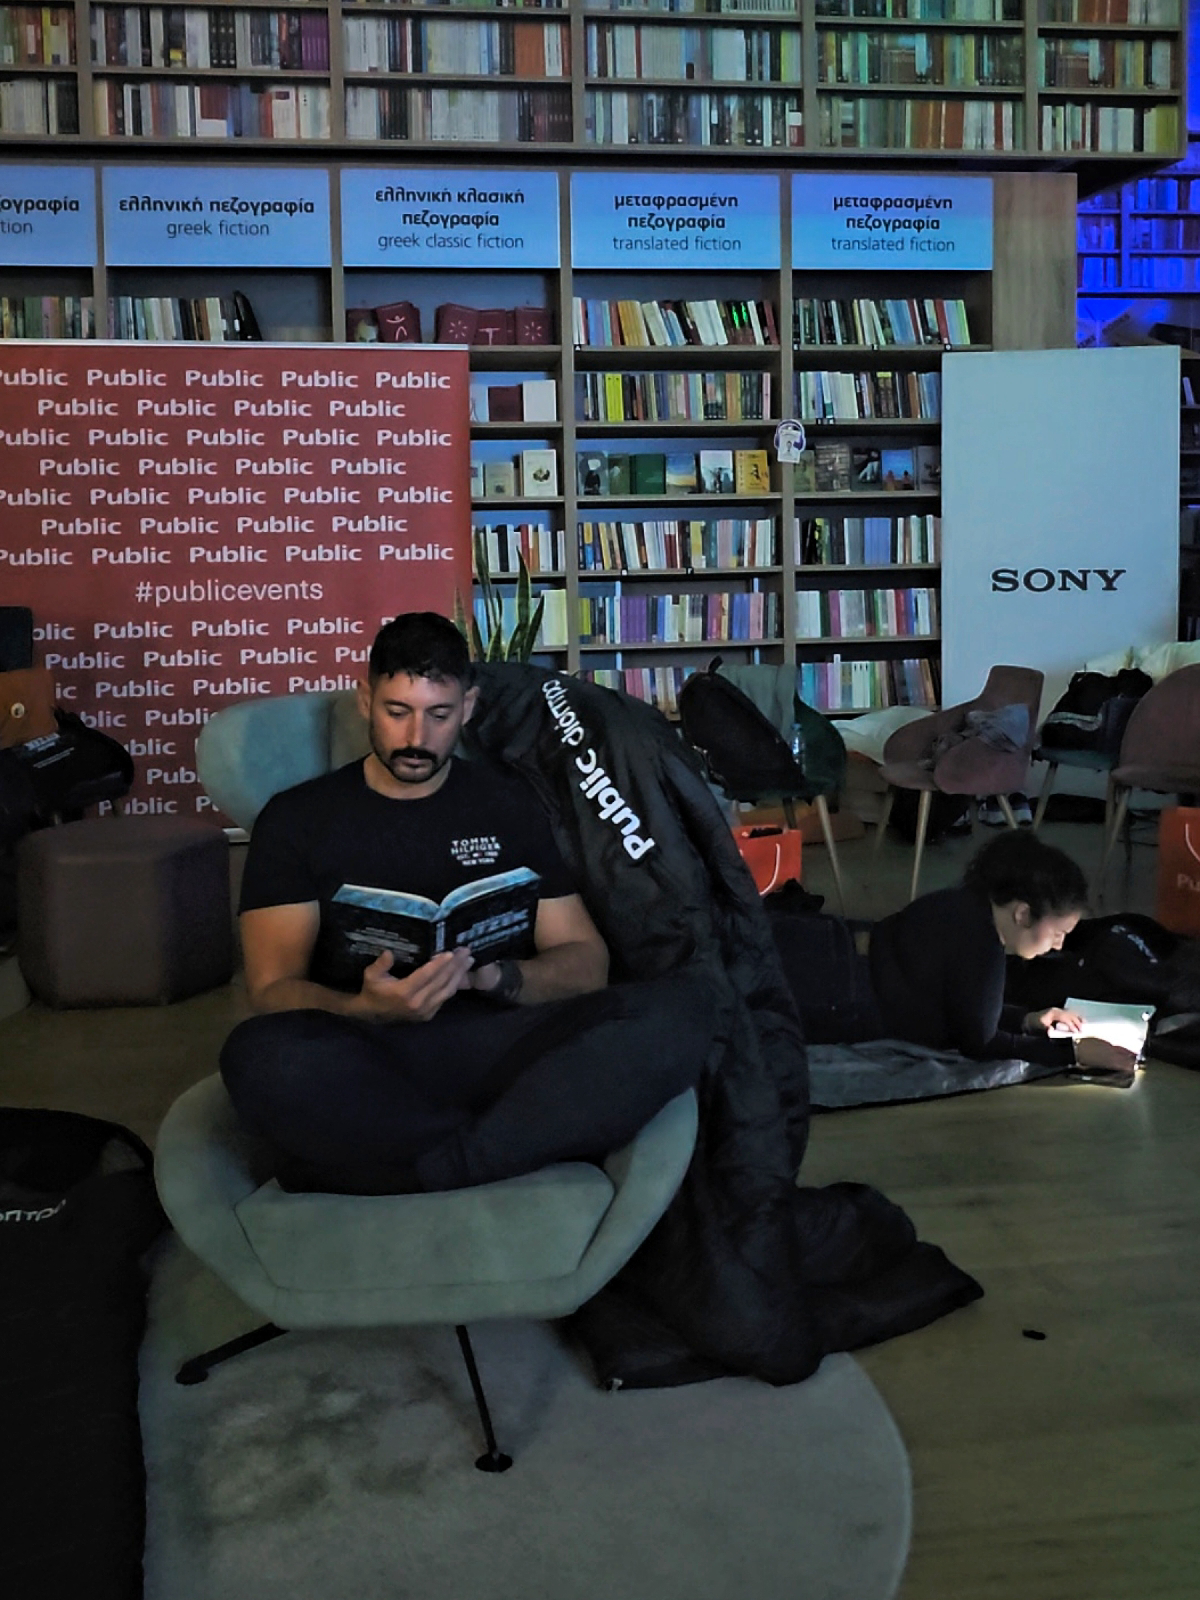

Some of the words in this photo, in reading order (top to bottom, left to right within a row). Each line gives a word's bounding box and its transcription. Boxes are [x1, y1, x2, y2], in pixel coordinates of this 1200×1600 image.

[375, 185, 452, 204] ελληνική
[456, 186, 525, 204] κλασική
[614, 193, 739, 212] μεταφρασμένη
[833, 194, 953, 213] μεταφρασμένη
[0, 195, 79, 215] ογραφία
[119, 195, 204, 212] ελληνική
[209, 196, 315, 217] πεζογραφία
[166, 219, 213, 238] greek
[218, 219, 270, 236] fiction
[402, 210, 500, 230] πεζογραφία
[627, 213, 726, 233] πεζογραφία
[845, 214, 941, 234] πεζογραφία
[377, 233, 422, 251] greek
[425, 233, 472, 249] classic
[476, 233, 524, 249] fiction
[612, 235, 689, 251] translated
[694, 235, 742, 251] fiction
[831, 236, 907, 252] translated
[911, 236, 955, 253] fiction
[87, 368, 167, 387] Public
[185, 369, 265, 388] Public
[281, 370, 359, 389] Public
[375, 370, 451, 389] Public
[37, 397, 119, 416] Public
[137, 398, 217, 417] Public
[234, 398, 313, 417] Public
[329, 399, 406, 418] Public
[88, 427, 169, 447] Public
[186, 428, 266, 447] Public
[282, 428, 361, 447] Public
[376, 429, 453, 447] Public
[39, 457, 121, 476] Public
[138, 457, 219, 476] Public
[235, 457, 314, 476] Public
[330, 457, 407, 476] Public
[89, 486, 171, 506] Public
[187, 486, 267, 505] Public
[283, 486, 361, 505] Public
[377, 485, 454, 504] Public
[41, 517, 122, 536] Public
[139, 516, 220, 536] Public
[236, 516, 316, 534] Public
[331, 515, 408, 533] Public
[91, 546, 172, 565] Public
[189, 545, 269, 564] Public
[285, 544, 362, 563] Public
[379, 543, 455, 562] Public
[991, 568, 1126, 592] SONY
[135, 579, 324, 608] #publicevents
[93, 621, 174, 640] Public
[191, 619, 270, 637] Public
[286, 616, 364, 635] Public
[45, 651, 125, 670] Public
[143, 648, 223, 668] Public
[239, 646, 318, 666] Public
[95, 680, 175, 698] Public
[193, 677, 272, 696] Public
[79, 710, 127, 728] blic
[575, 748, 655, 860] Public
[451, 836, 497, 848] TOMMY
